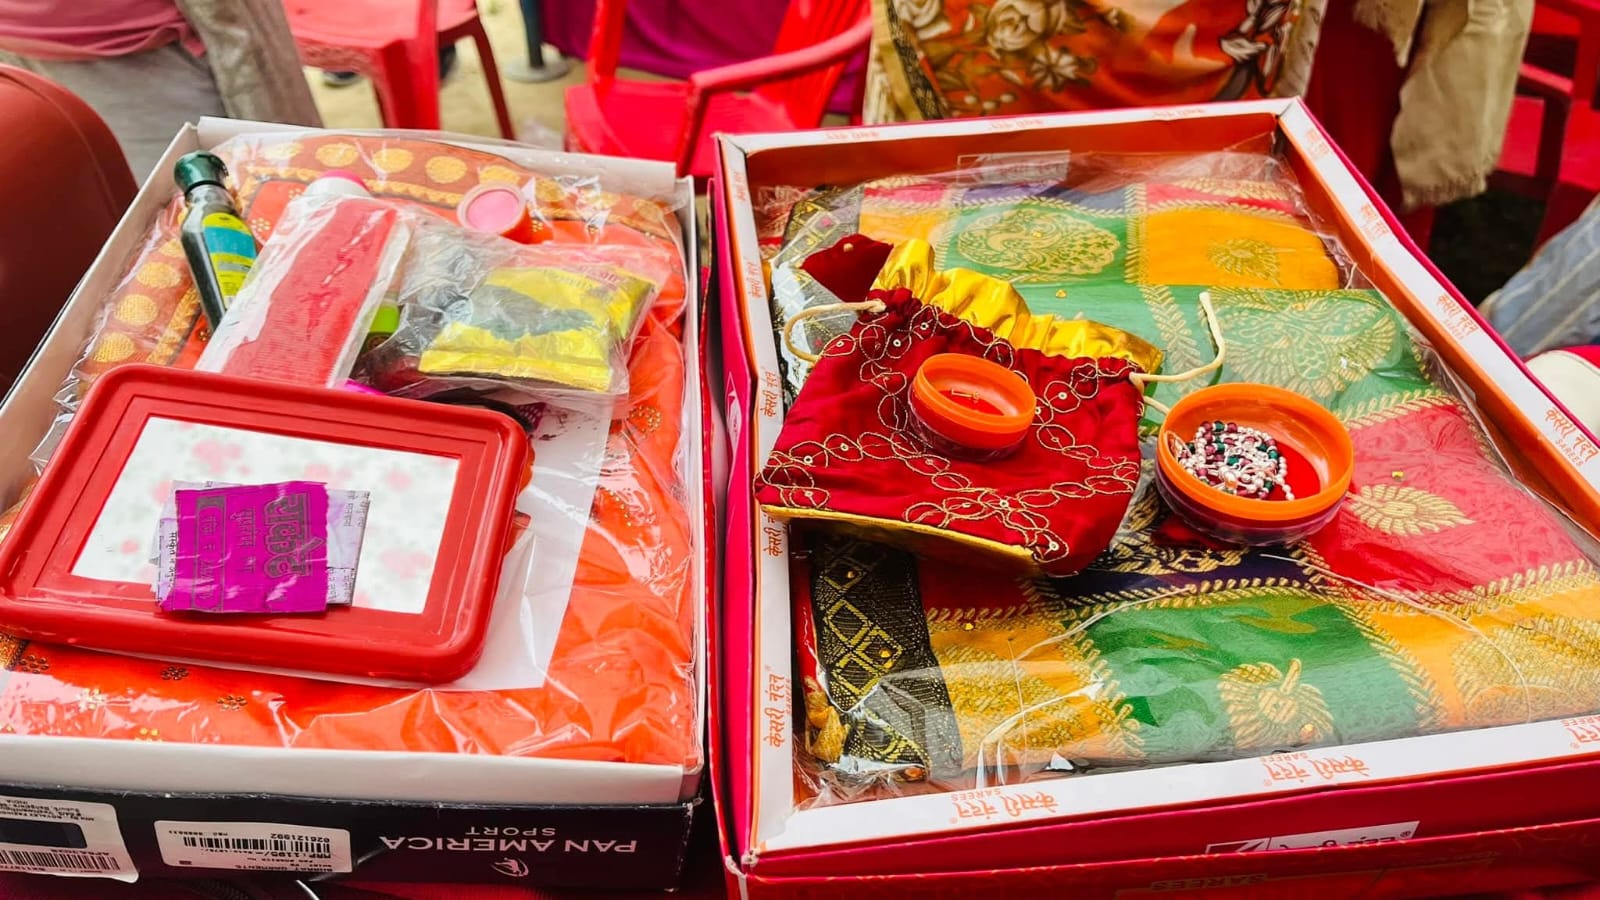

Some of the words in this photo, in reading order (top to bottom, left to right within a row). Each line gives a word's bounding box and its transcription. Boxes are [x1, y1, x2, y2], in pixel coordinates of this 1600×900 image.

[764, 673, 785, 703] नंदन
[763, 707, 785, 748] केसरी
[1263, 763, 1311, 783] नंदन
[1309, 756, 1370, 780] केसरी
[951, 789, 1000, 801] SAREES
[1001, 792, 1059, 817] केसरी
[953, 800, 999, 820] नंदन
[465, 826, 556, 837] SPORT
[379, 836, 555, 852] AMERICA
[564, 839, 638, 853] PAN
